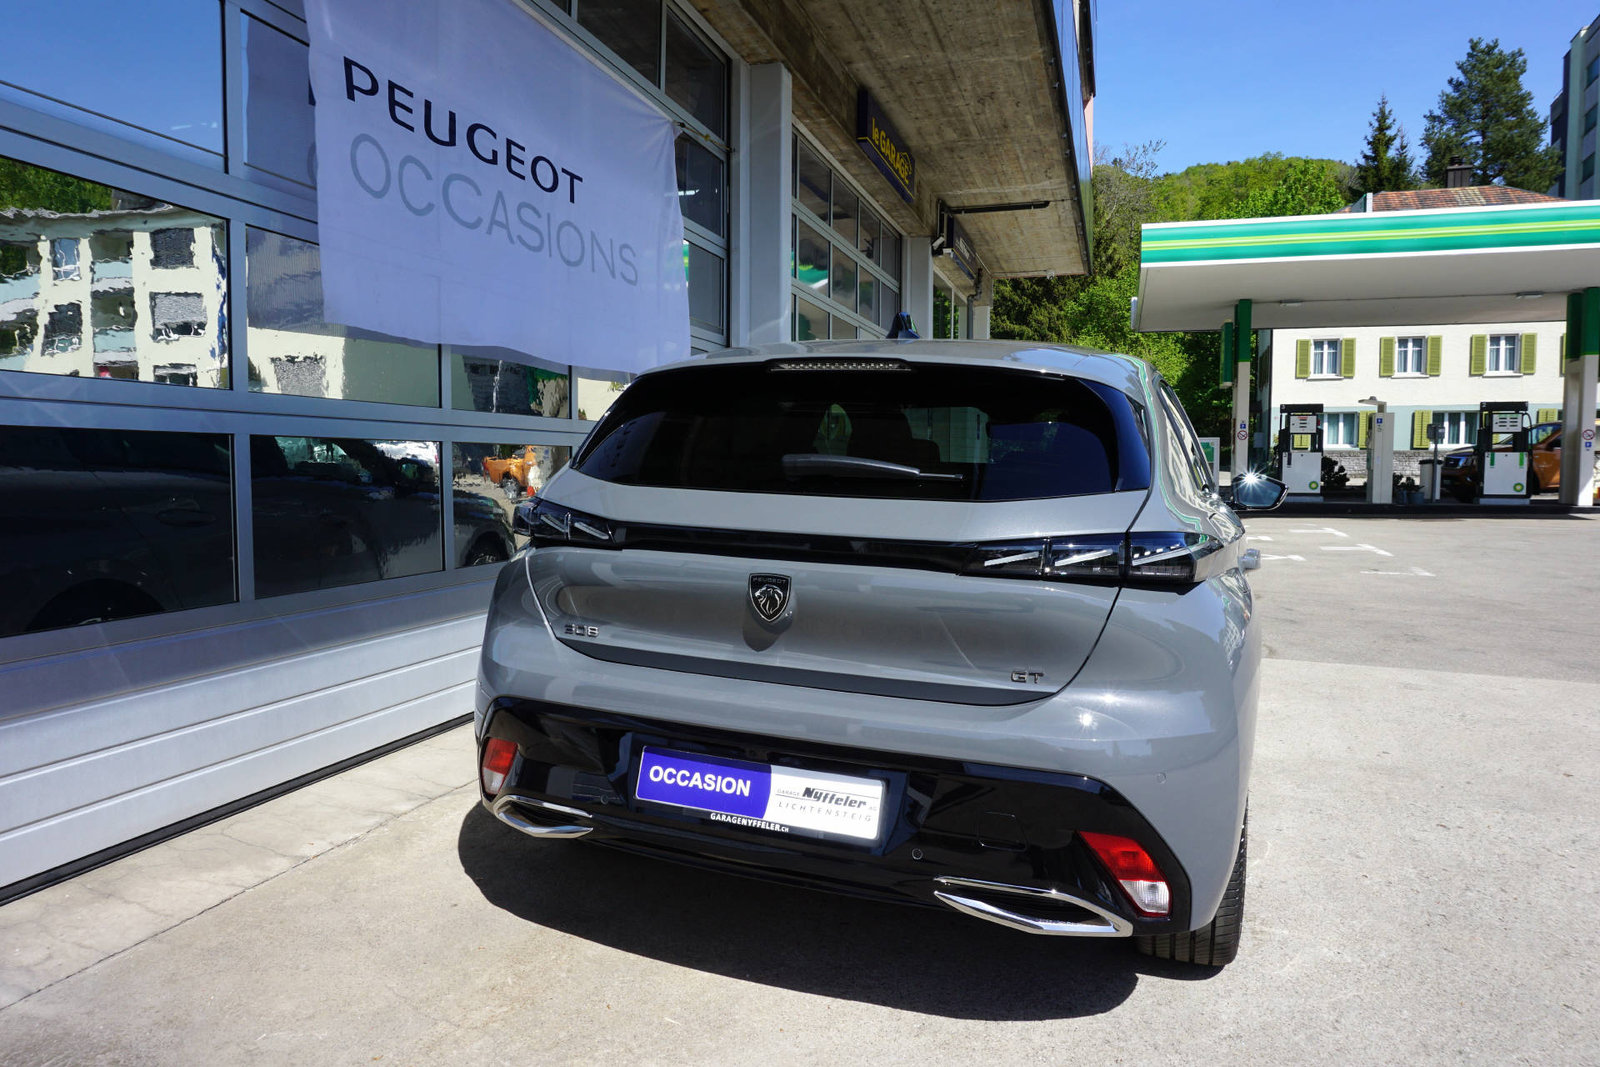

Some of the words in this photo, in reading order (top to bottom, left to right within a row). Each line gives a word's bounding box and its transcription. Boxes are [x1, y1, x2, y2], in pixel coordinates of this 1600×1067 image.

[343, 56, 583, 203] PEUGEOT
[872, 117, 879, 145] le
[880, 130, 909, 184] GARAGE
[350, 133, 638, 286] OCCASIONS
[564, 623, 599, 637] 308
[1011, 671, 1044, 684] GT
[649, 765, 751, 797] OCCASION
[777, 788, 800, 796] GARAGE
[802, 787, 867, 808] Nyffeler
[710, 812, 789, 832] GARAGENYFFELER.CH
[778, 802, 871, 821] LICHTENSTEIG
